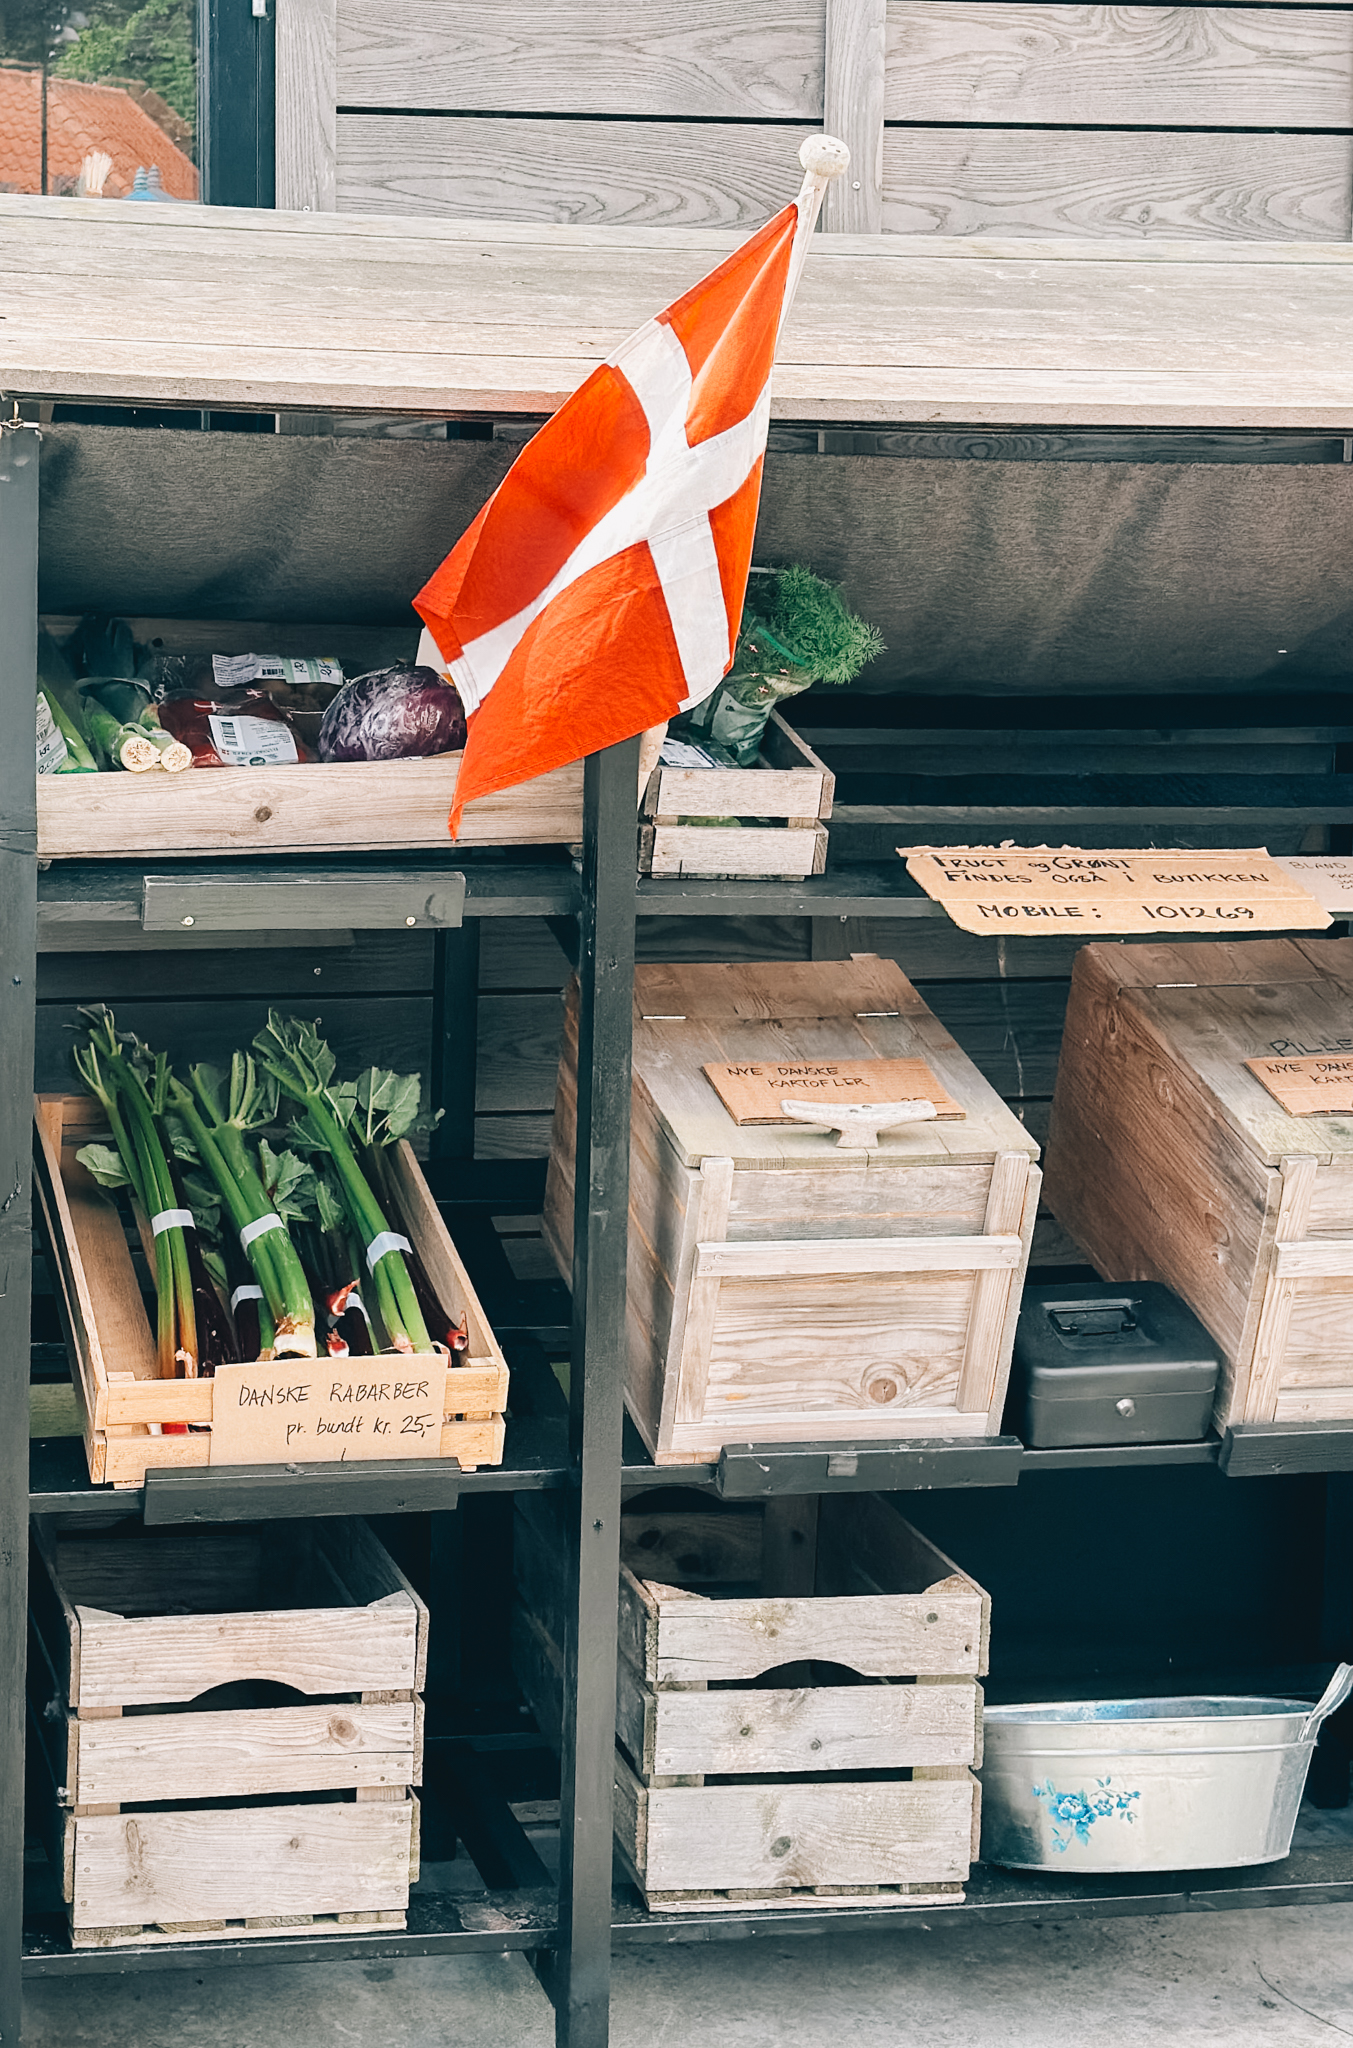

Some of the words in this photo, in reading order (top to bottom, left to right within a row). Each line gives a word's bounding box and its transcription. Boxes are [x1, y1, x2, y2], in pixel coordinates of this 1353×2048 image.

[1027, 862, 1051, 873] og
[1152, 873, 1270, 884] BUTIKKEN
[1141, 904, 1255, 919] 101269
[726, 1066, 763, 1077] NYE
[777, 1066, 839, 1077] DANSKE
[1265, 1063, 1304, 1074] NYE
[238, 1384, 313, 1407] DANSKE
[329, 1380, 430, 1403] RABARBER
[286, 1422, 307, 1446] pr.
[316, 1415, 364, 1436] bundt
[399, 1413, 436, 1438] 25,-
